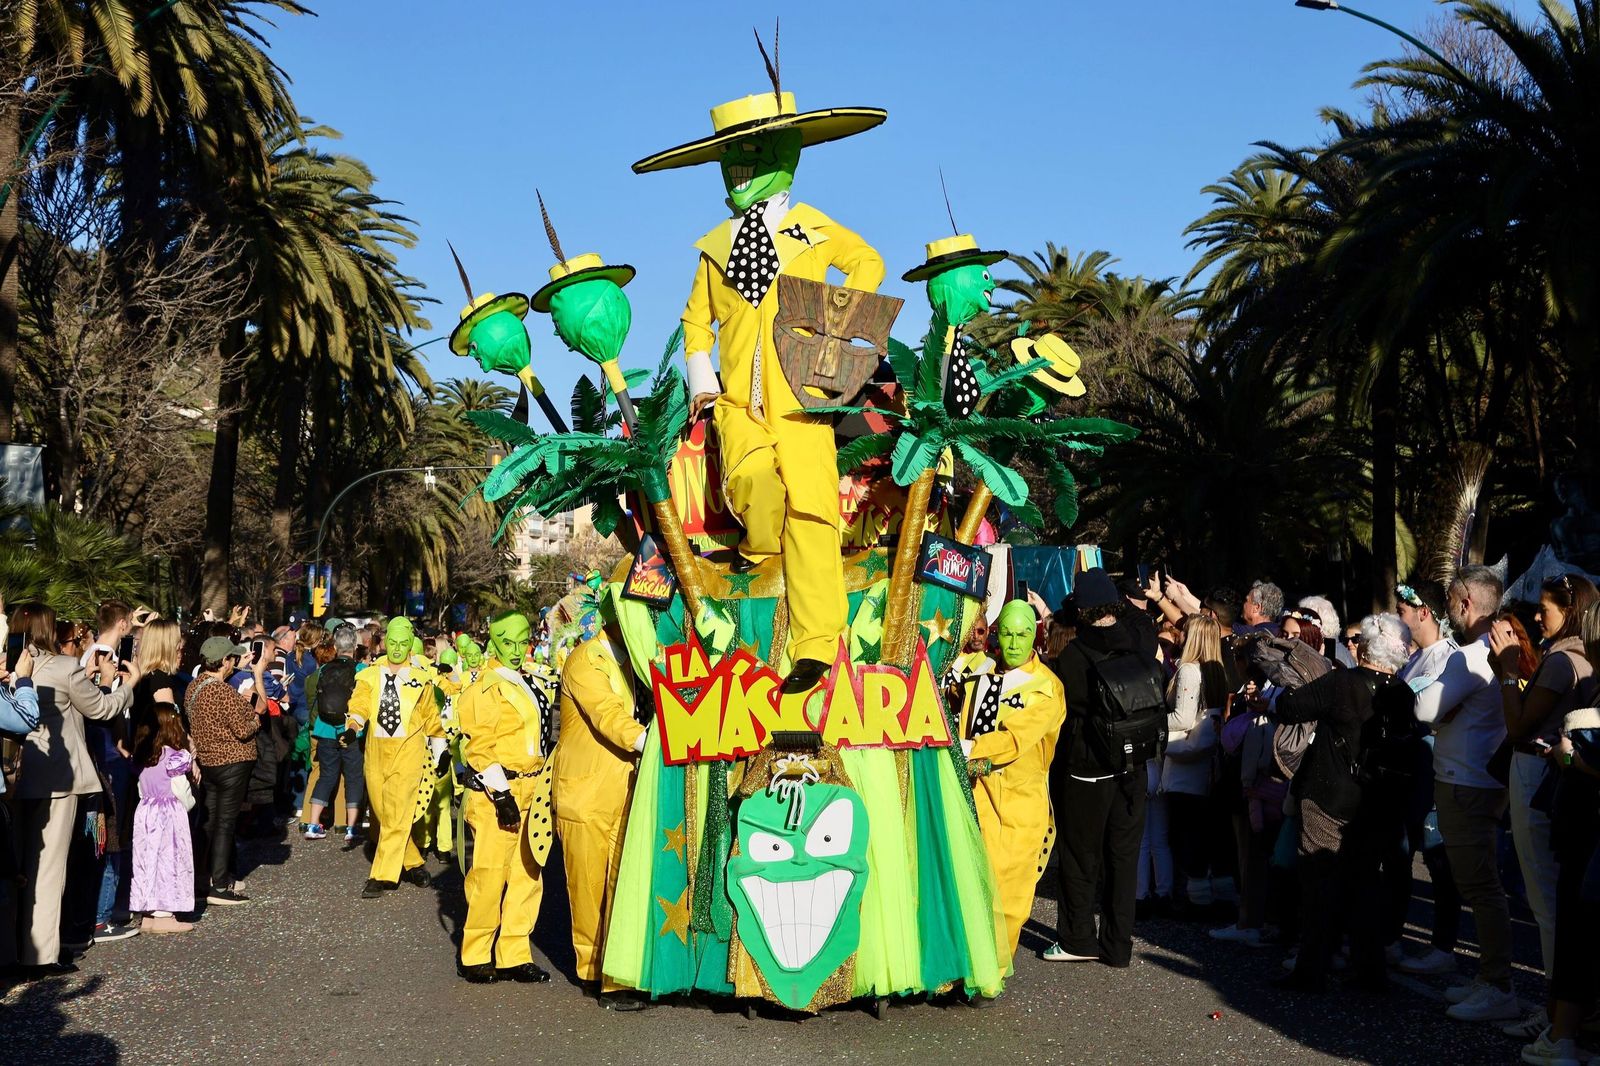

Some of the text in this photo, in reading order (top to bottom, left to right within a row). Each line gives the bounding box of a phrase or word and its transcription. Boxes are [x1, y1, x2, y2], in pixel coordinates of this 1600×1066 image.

[842, 497, 858, 513] LA
[669, 646, 710, 683] LA
[658, 658, 949, 761] MÁSCARA
